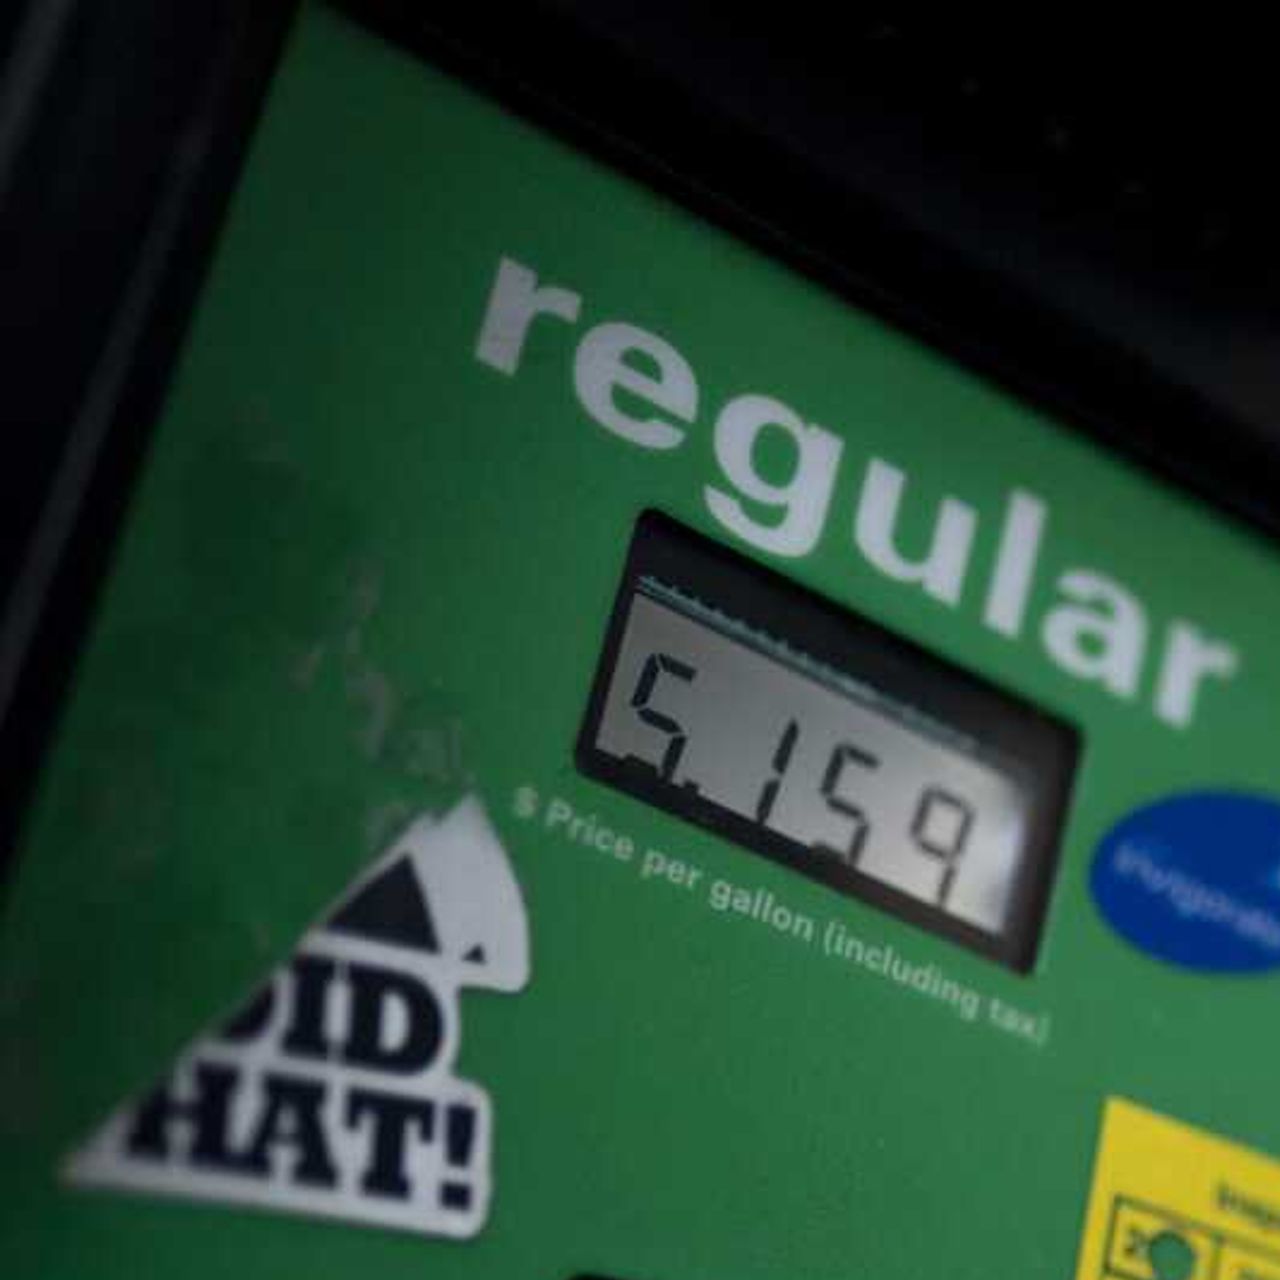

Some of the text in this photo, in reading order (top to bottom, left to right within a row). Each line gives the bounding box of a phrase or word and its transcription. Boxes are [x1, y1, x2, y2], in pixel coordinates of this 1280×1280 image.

[474, 255, 1238, 729] regular
[632, 653, 973, 912] 5.159
[545, 797, 635, 862] Price
[639, 847, 701, 890] per
[709, 878, 815, 944] gallon
[822, 922, 981, 1023] (including
[989, 999, 1051, 1046] tax)
